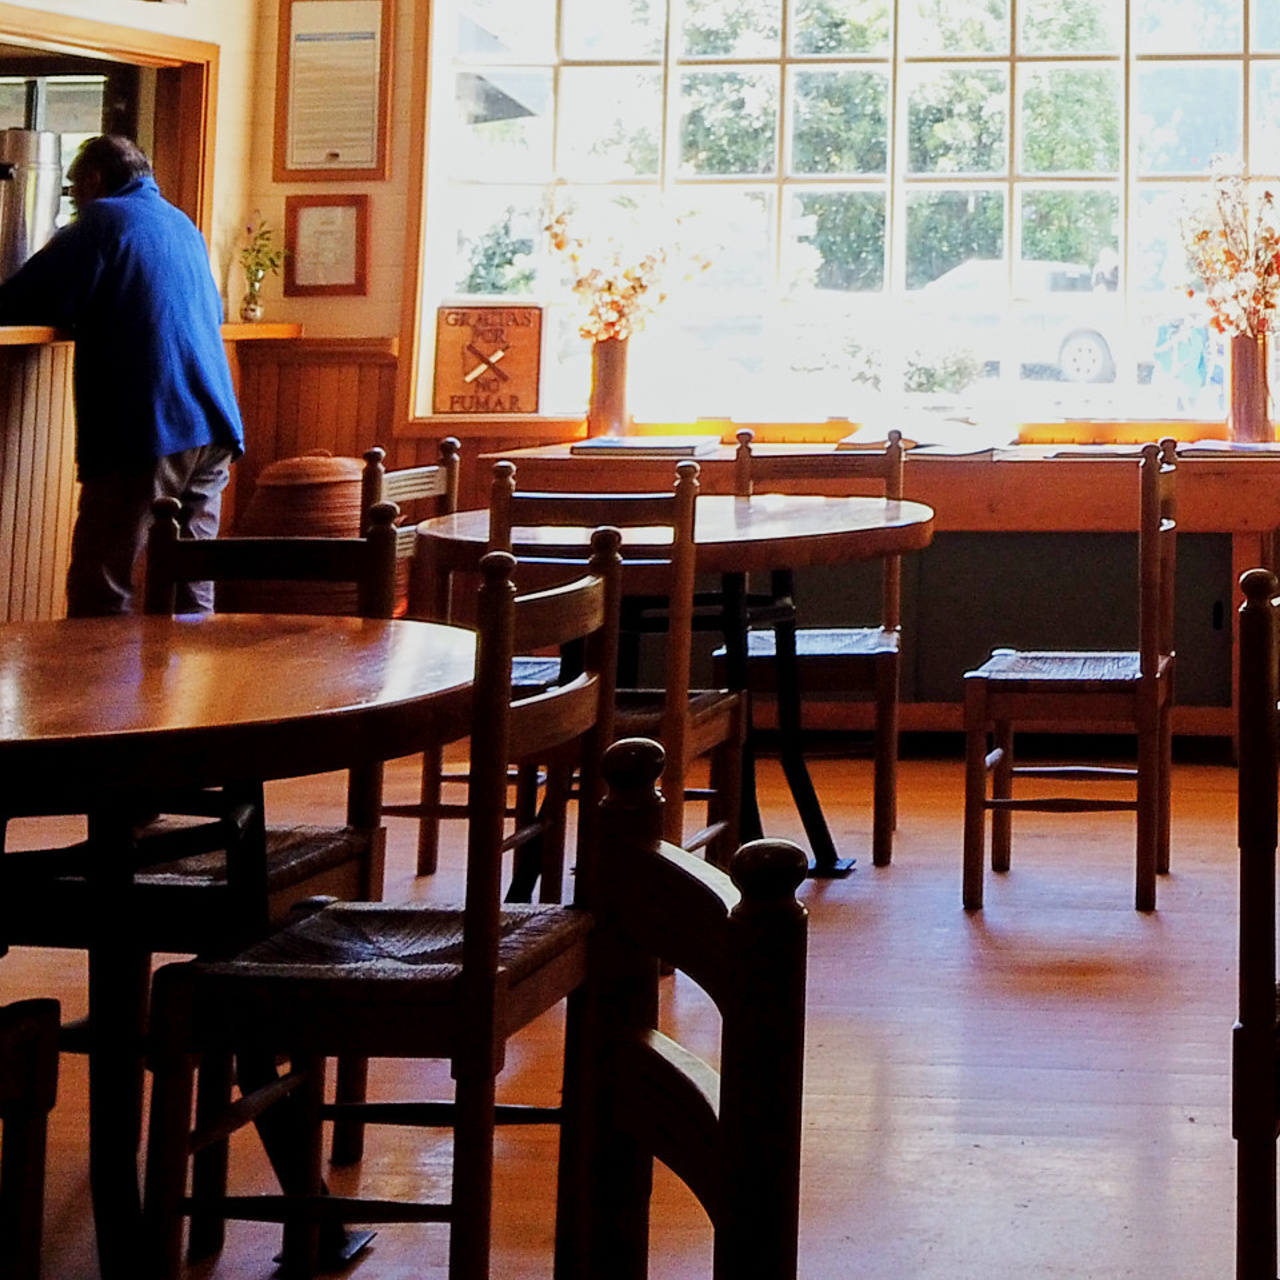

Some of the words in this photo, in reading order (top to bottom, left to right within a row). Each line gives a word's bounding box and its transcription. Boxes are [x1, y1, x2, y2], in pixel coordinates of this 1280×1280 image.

[445, 311, 533, 327] GRACIAS
[472, 327, 507, 343] POR
[475, 378, 500, 393] NO
[449, 395, 521, 411] FUMAR
